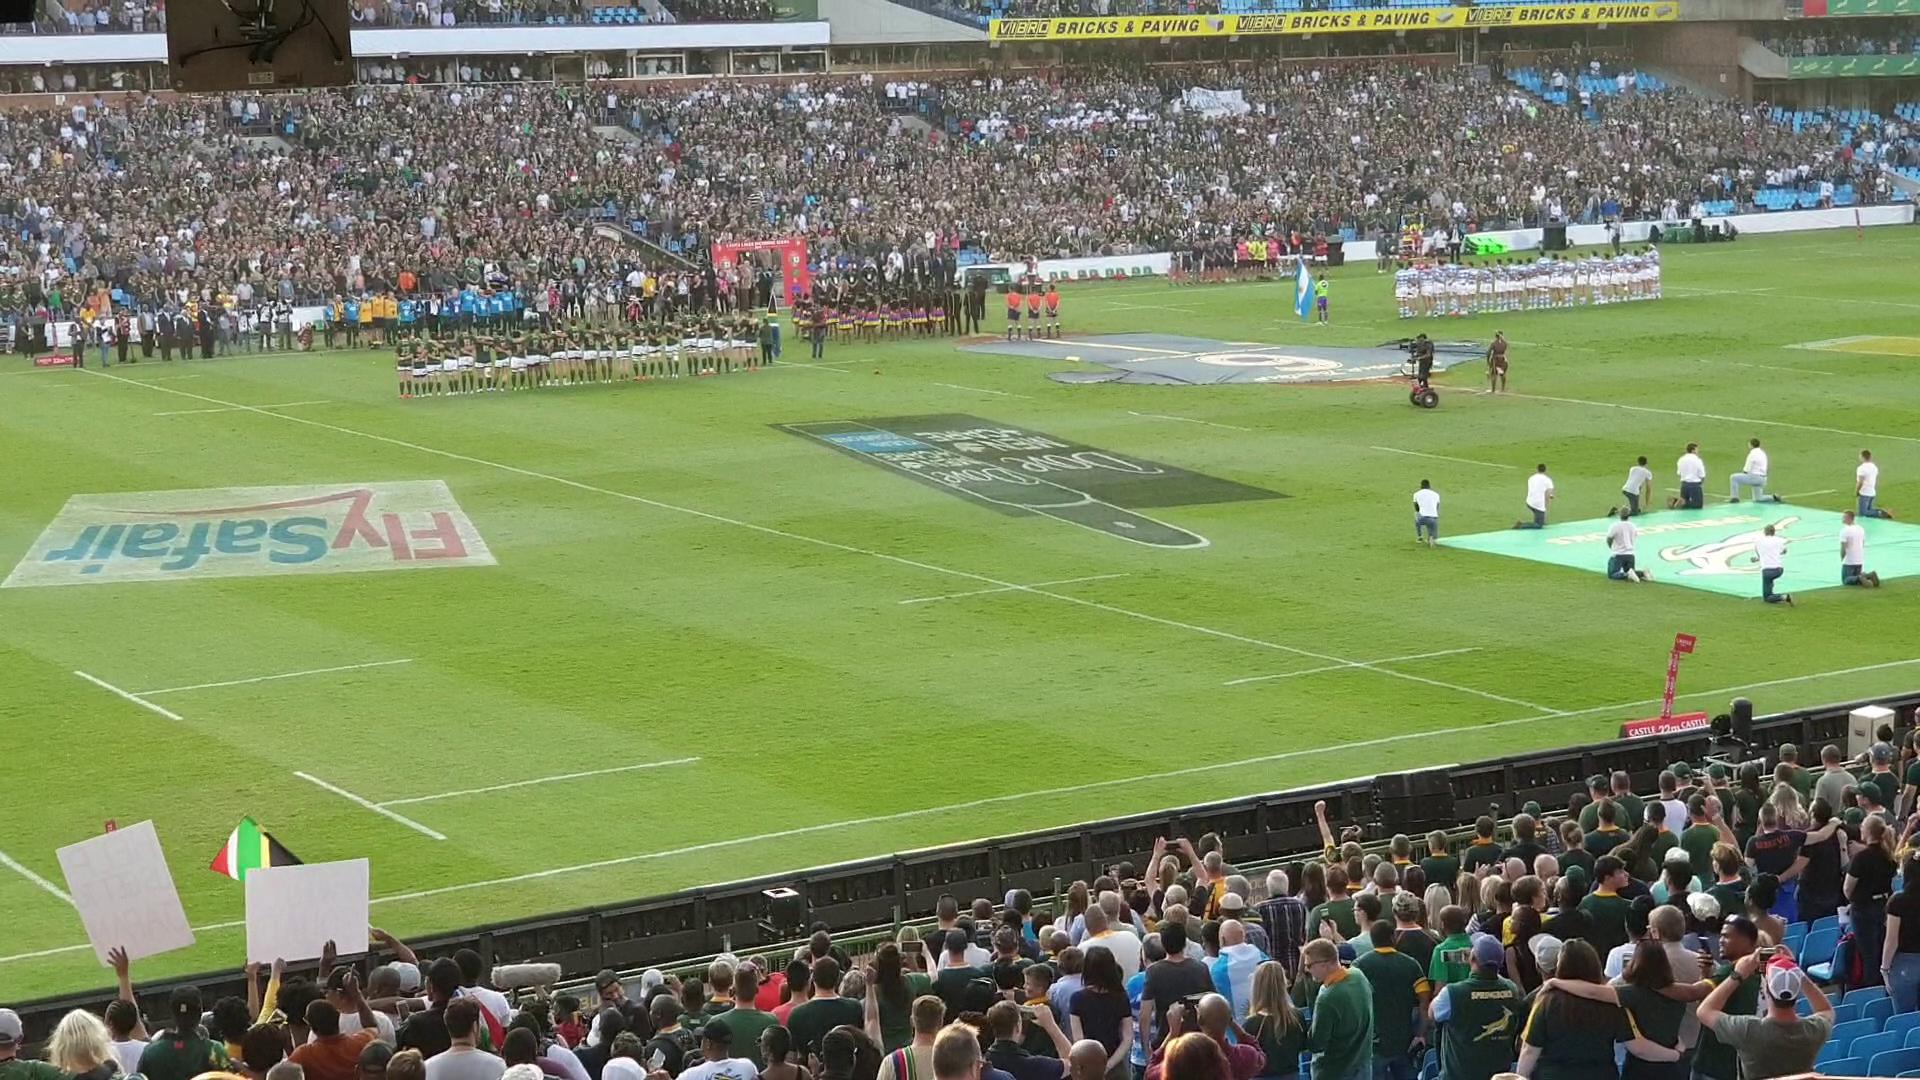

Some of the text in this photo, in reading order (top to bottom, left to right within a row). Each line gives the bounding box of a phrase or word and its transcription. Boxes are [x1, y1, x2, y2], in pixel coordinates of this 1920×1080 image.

[1236, 12, 1430, 32] VIBRO BRICKS & PAVING
[1466, 6, 1650, 25] VIBRO BRICKS & PAVING
[997, 18, 1200, 38] VIBRO BRICKS & PAVING
[1001, 452, 1164, 474] Dove
[932, 467, 1040, 487] Dove
[1628, 718, 1706, 737] CASTLE 22m CASTLE
